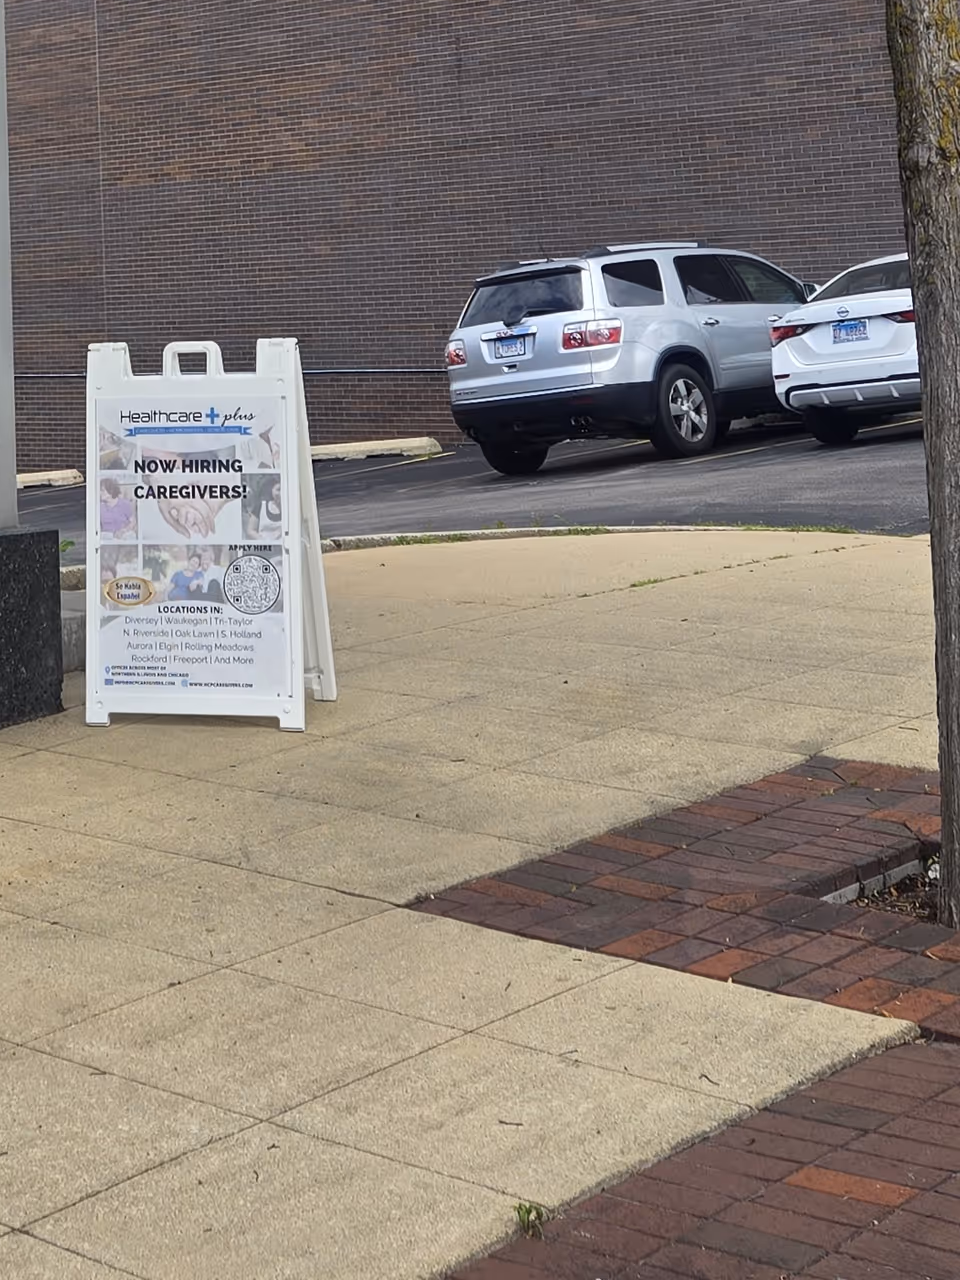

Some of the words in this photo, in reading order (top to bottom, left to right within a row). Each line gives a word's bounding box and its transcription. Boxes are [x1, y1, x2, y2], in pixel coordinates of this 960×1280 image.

[120, 410, 202, 423] Healthcare
[221, 407, 256, 427] plus
[134, 460, 177, 473] NOW
[182, 459, 242, 473] HIRING
[134, 485, 247, 499] CAREGIVERS!
[116, 582, 123, 590] Se
[125, 582, 141, 590] Habla
[158, 606, 208, 614] LOCATIONS
[125, 617, 158, 626] Diversey
[164, 618, 208, 626] Waukegan
[214, 618, 253, 627] Tri-Taylor
[133, 630, 169, 638] Riverside
[127, 642, 153, 650] Aurora
[159, 643, 179, 652] Elgin
[185, 643, 212, 652] Rolling
[214, 644, 254, 652] Meadows
[132, 655, 168, 663] Rockford
[173, 656, 208, 665] Freeport
[214, 656, 231, 664] And
